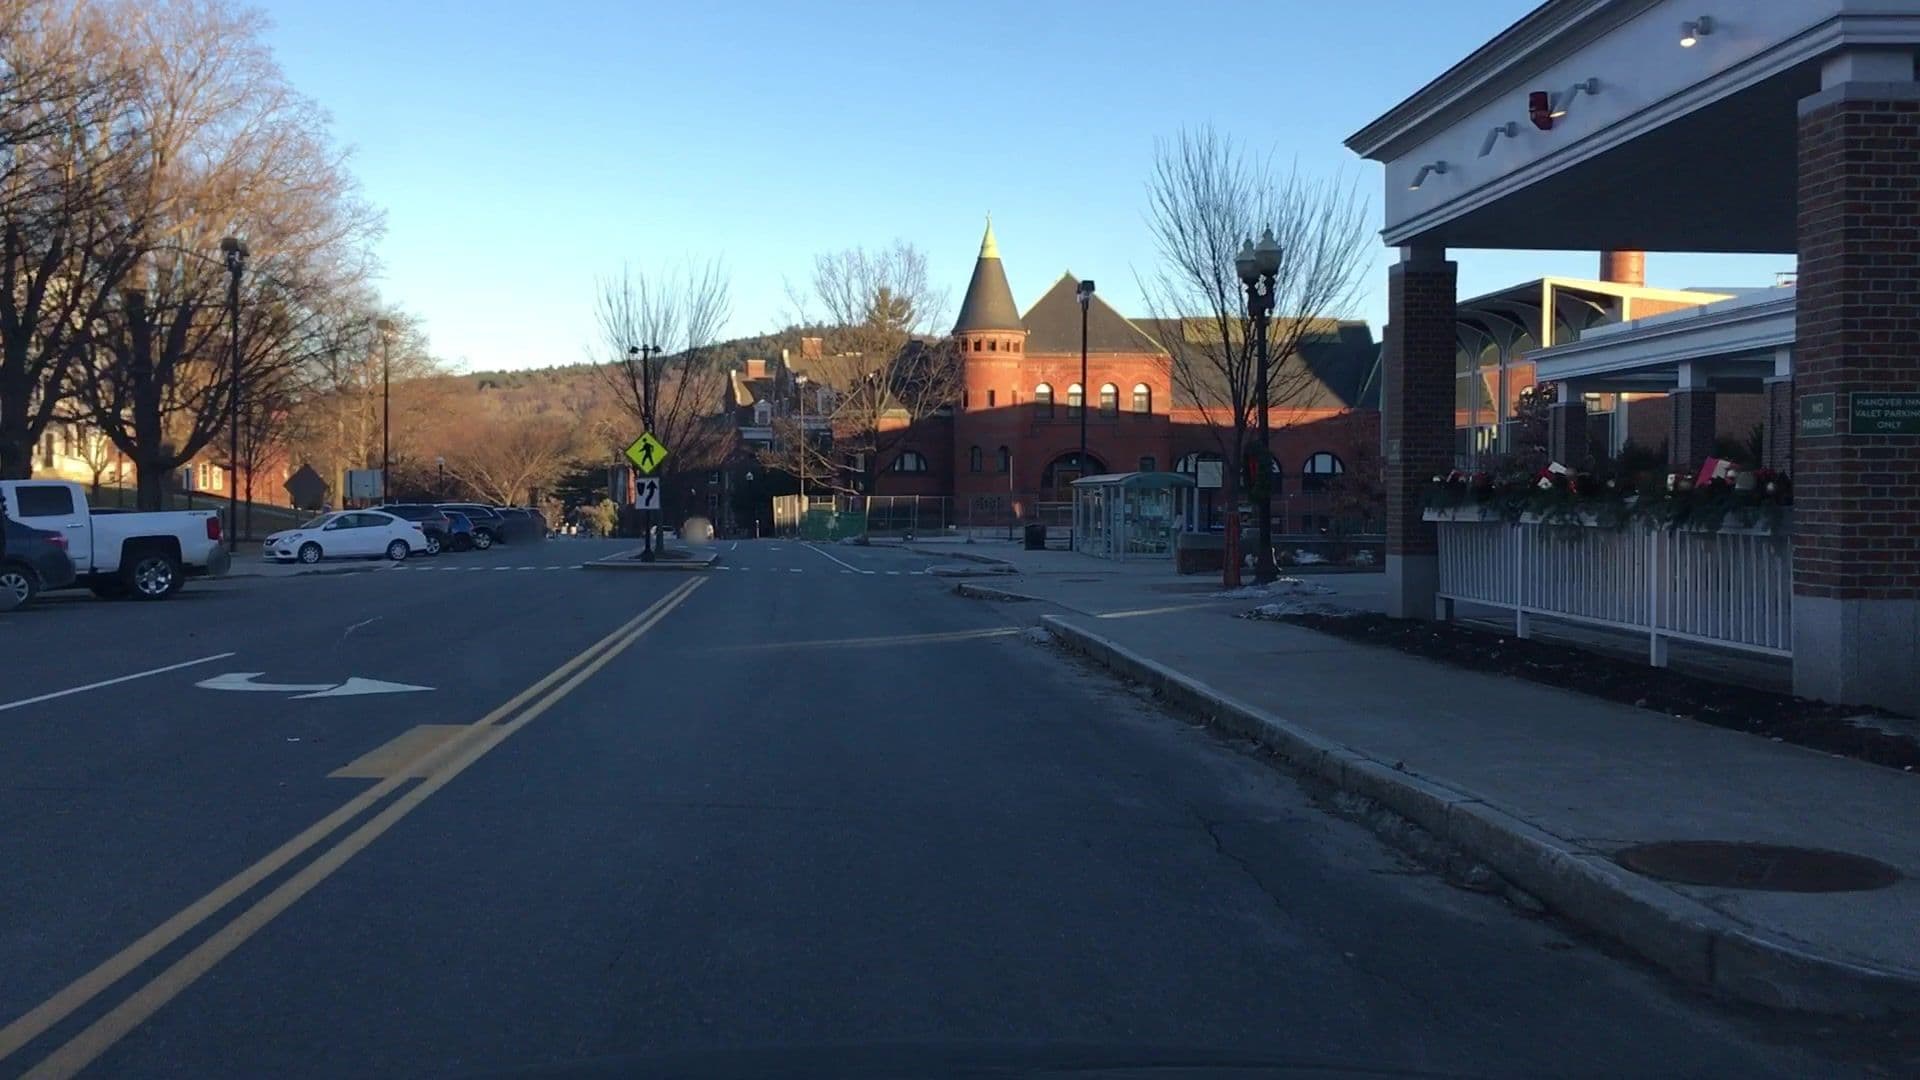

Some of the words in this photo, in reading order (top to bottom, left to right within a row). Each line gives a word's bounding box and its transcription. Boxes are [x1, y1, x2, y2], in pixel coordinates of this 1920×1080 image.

[1856, 398, 1902, 407] HANOVER
[1812, 402, 1824, 413] NO
[1855, 409, 1881, 418] VALET
[1877, 421, 1901, 429] ONLY
